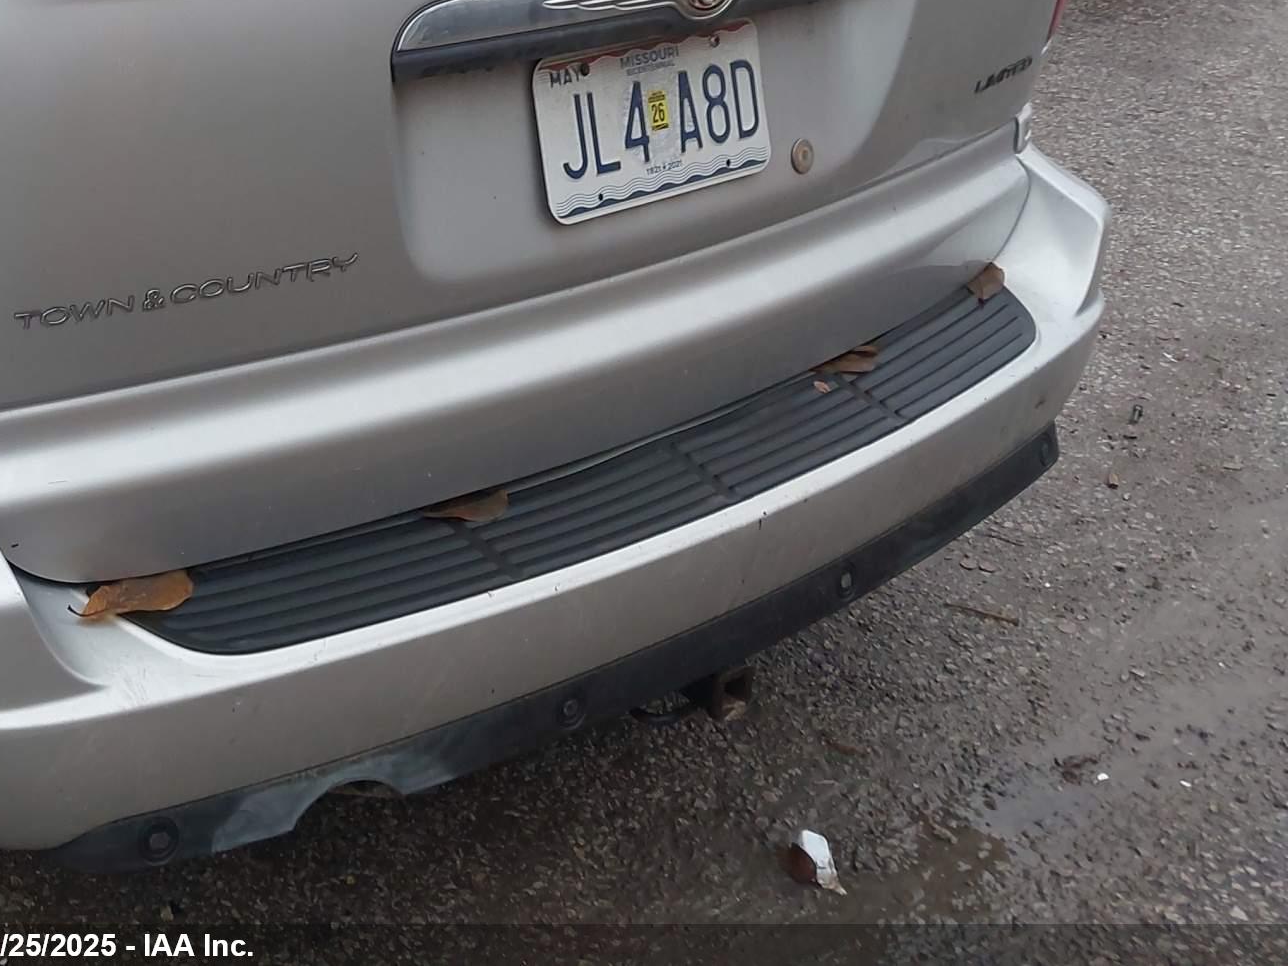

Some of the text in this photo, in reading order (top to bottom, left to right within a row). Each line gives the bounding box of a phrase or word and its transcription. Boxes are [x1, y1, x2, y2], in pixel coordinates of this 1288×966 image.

[619, 45, 680, 70] MISSOURI
[550, 68, 580, 88] MAY
[651, 102, 665, 123] 26
[13, 252, 359, 330] TOWN & COUNTRY
